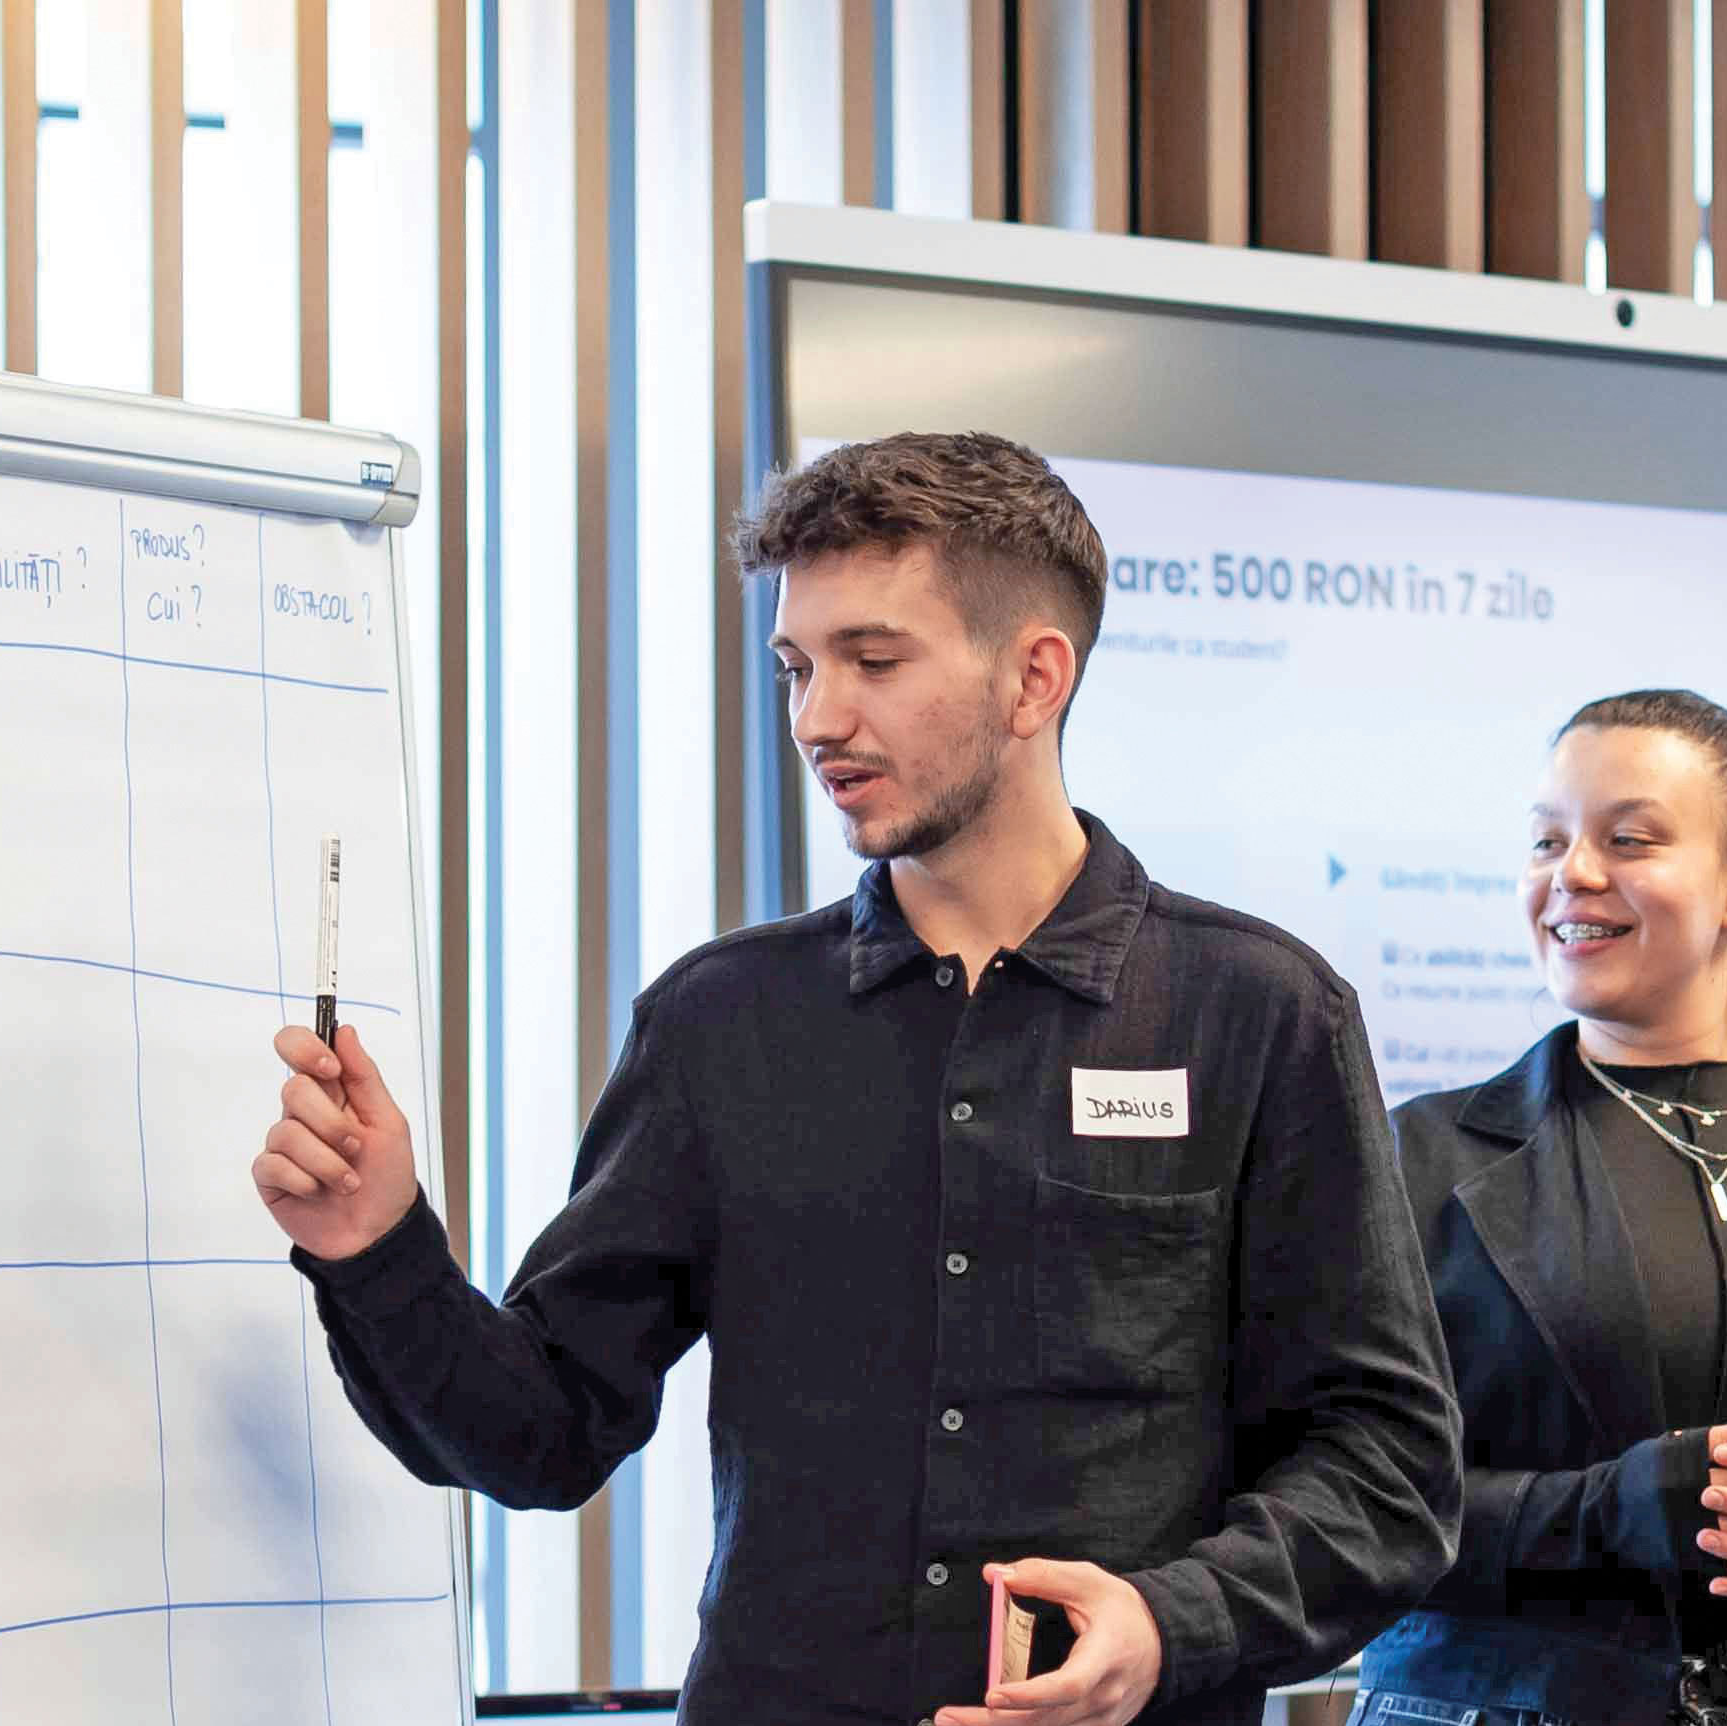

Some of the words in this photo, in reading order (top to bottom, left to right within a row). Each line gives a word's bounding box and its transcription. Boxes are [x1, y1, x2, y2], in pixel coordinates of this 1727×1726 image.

[1113, 556, 1199, 597] are:
[1212, 553, 1293, 600] 500
[1306, 561, 1395, 609] RON
[1456, 570, 1477, 615] 7
[1485, 568, 1556, 621] zile
